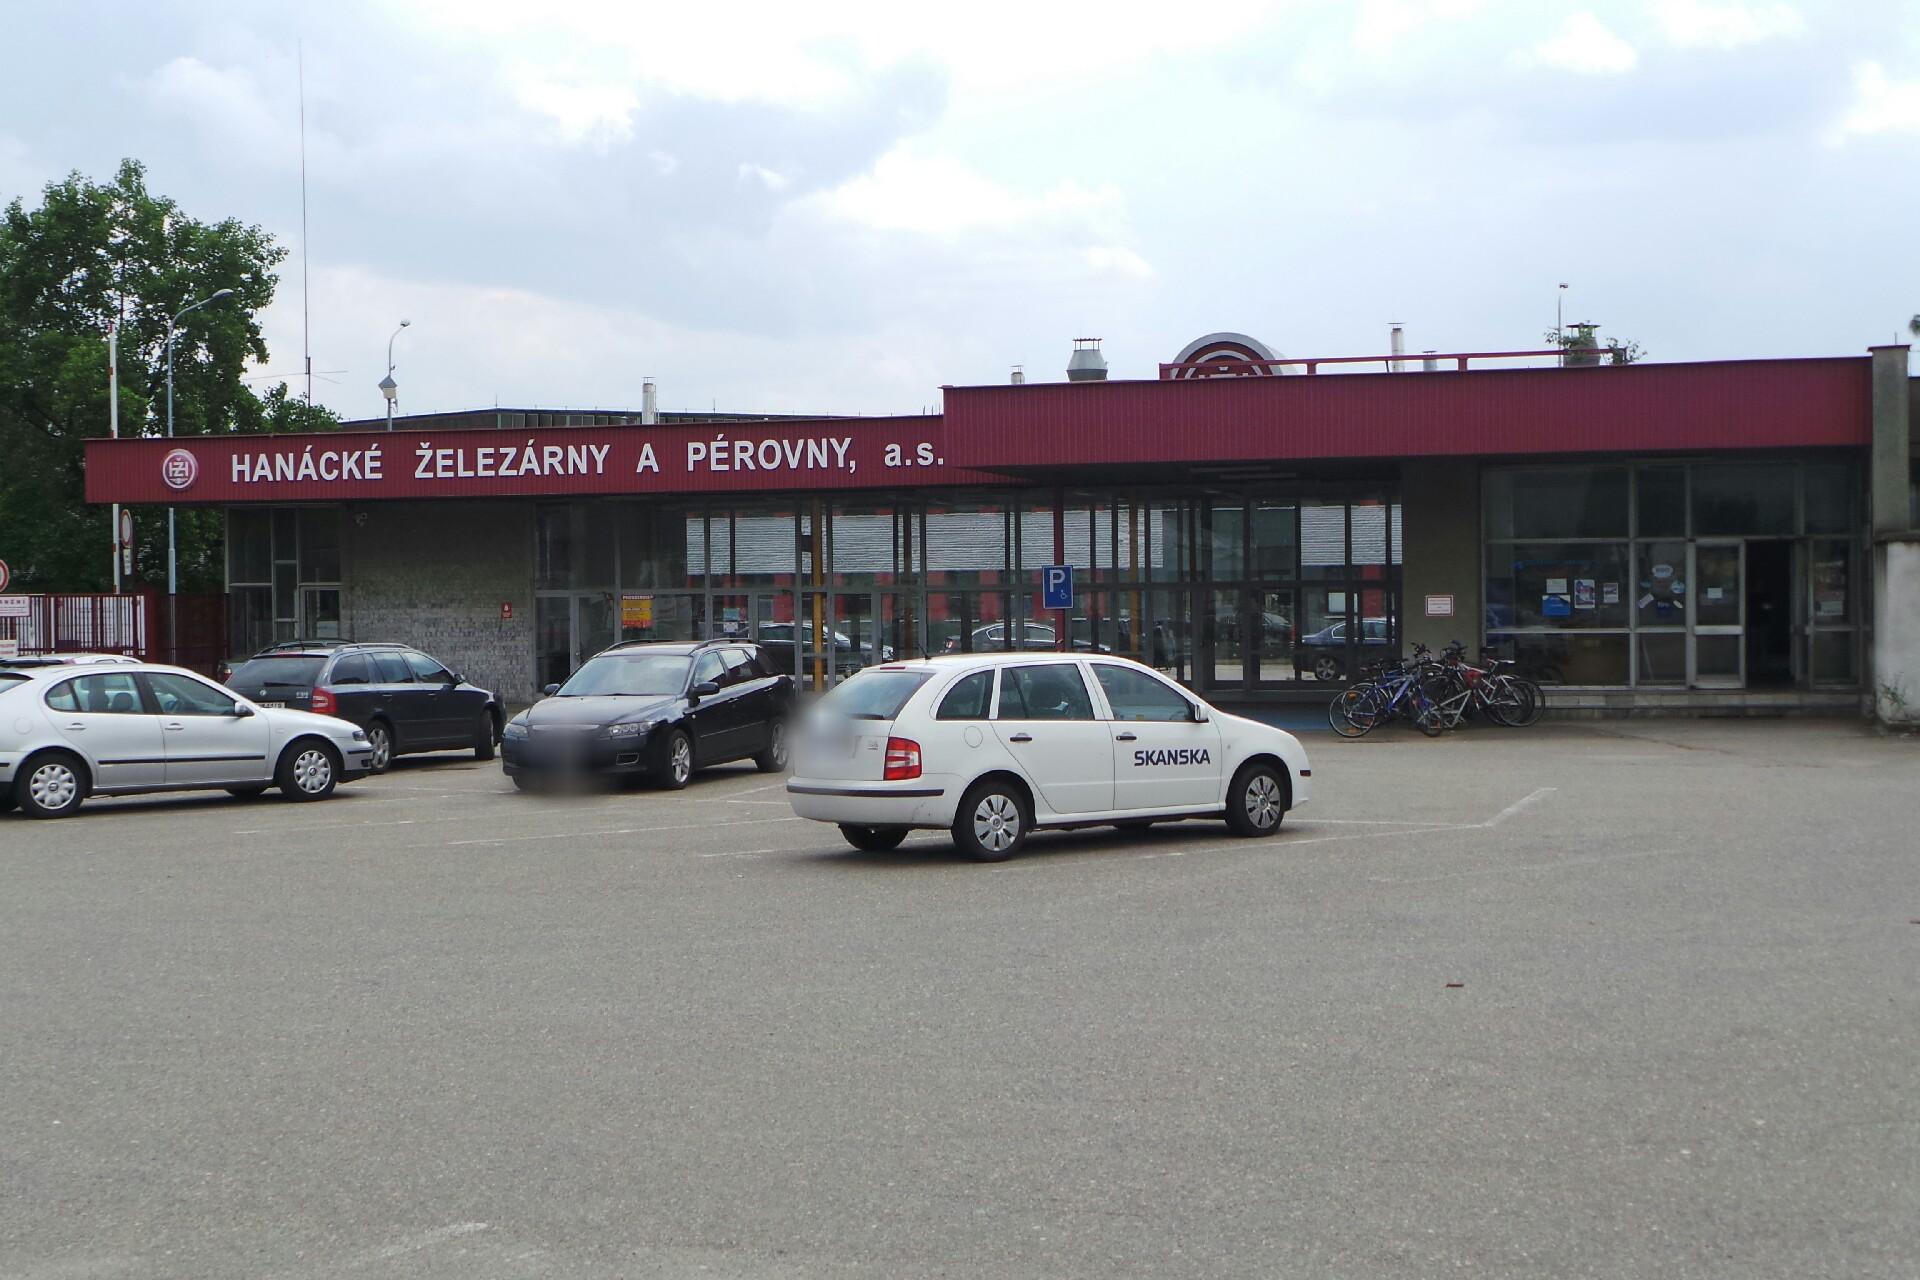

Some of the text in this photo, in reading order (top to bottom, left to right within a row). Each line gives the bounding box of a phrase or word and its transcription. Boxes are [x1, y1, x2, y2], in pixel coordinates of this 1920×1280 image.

[231, 433, 944, 483] HANÁCKÉ ŽELEZÁRNY A PÉROVNY, a.s.
[1049, 569, 1066, 593] P
[1134, 749, 1211, 767] SKANSKA
